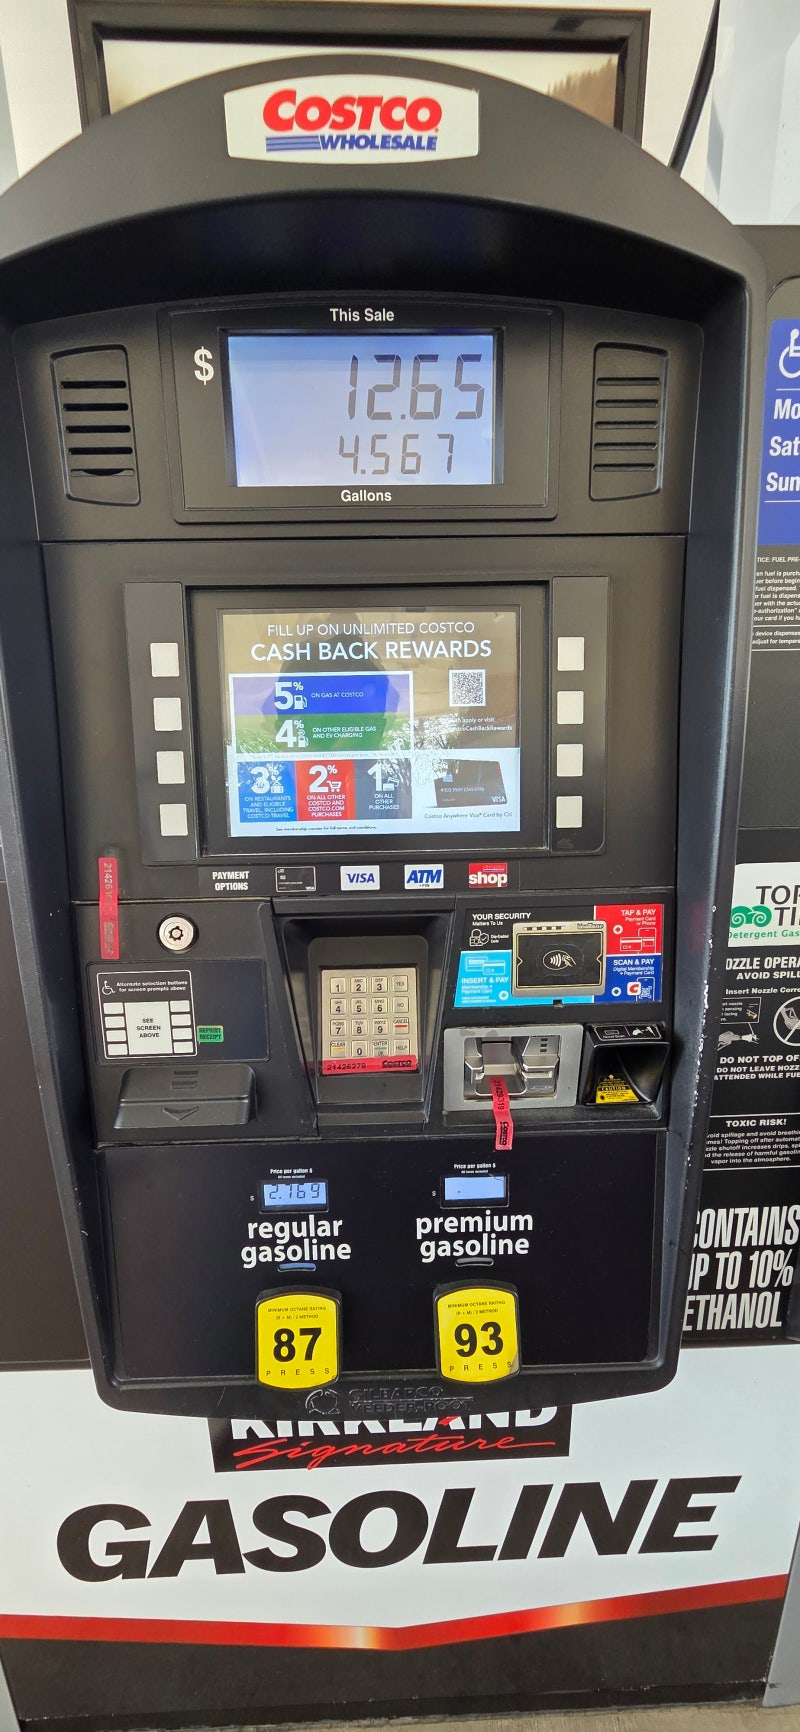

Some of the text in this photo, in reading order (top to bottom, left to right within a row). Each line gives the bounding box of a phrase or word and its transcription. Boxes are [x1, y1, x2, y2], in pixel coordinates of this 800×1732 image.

[262, 89, 442, 133] COSTCO
[319, 135, 437, 151] WHOLESALE
[330, 308, 394, 321] This Sale
[194, 346, 214, 385] $
[348, 353, 485, 420] 12.65
[769, 435, 800, 456] Sat
[339, 434, 455, 475] 4.567
[340, 489, 392, 502] Gallons
[268, 622, 475, 637] FILL UP ON UNLIMITED COSTCO
[251, 640, 492, 661] CASH BACK REWARDS
[491, 795, 506, 803] VISA
[212, 871, 250, 880] PAYMENT
[346, 873, 375, 884] VISA
[407, 870, 442, 884] ATM
[469, 872, 508, 888] shop
[215, 882, 249, 891] OPTIONS
[495, 912, 532, 920] SECURITY
[774, 906, 800, 927] TI
[736, 972, 770, 980] AVOID
[356, 984, 362, 992] 2
[356, 1005, 362, 1013] 5
[377, 1004, 383, 1012] 6
[336, 1027, 341, 1035] 7
[357, 1026, 362, 1034] 8
[378, 1026, 383, 1034] 9
[357, 1048, 362, 1056] 0
[738, 1056, 760, 1064] NOT
[762, 1055, 784, 1063] TOP
[726, 1119, 787, 1128] TOXIC RISK!
[269, 1184, 320, 1200] 2.169
[248, 1214, 343, 1244] regular
[416, 1210, 534, 1240] premium
[241, 1239, 352, 1269] gasoline
[420, 1234, 530, 1263] gasoline
[716, 1251, 742, 1290] TO
[749, 1248, 794, 1288] 10%
[683, 1292, 782, 1331] ETHANOL
[273, 1328, 322, 1363] 87
[454, 1322, 504, 1358] 93
[233, 1434, 556, 1471] Signature
[56, 1475, 742, 1583] GASOLINE
